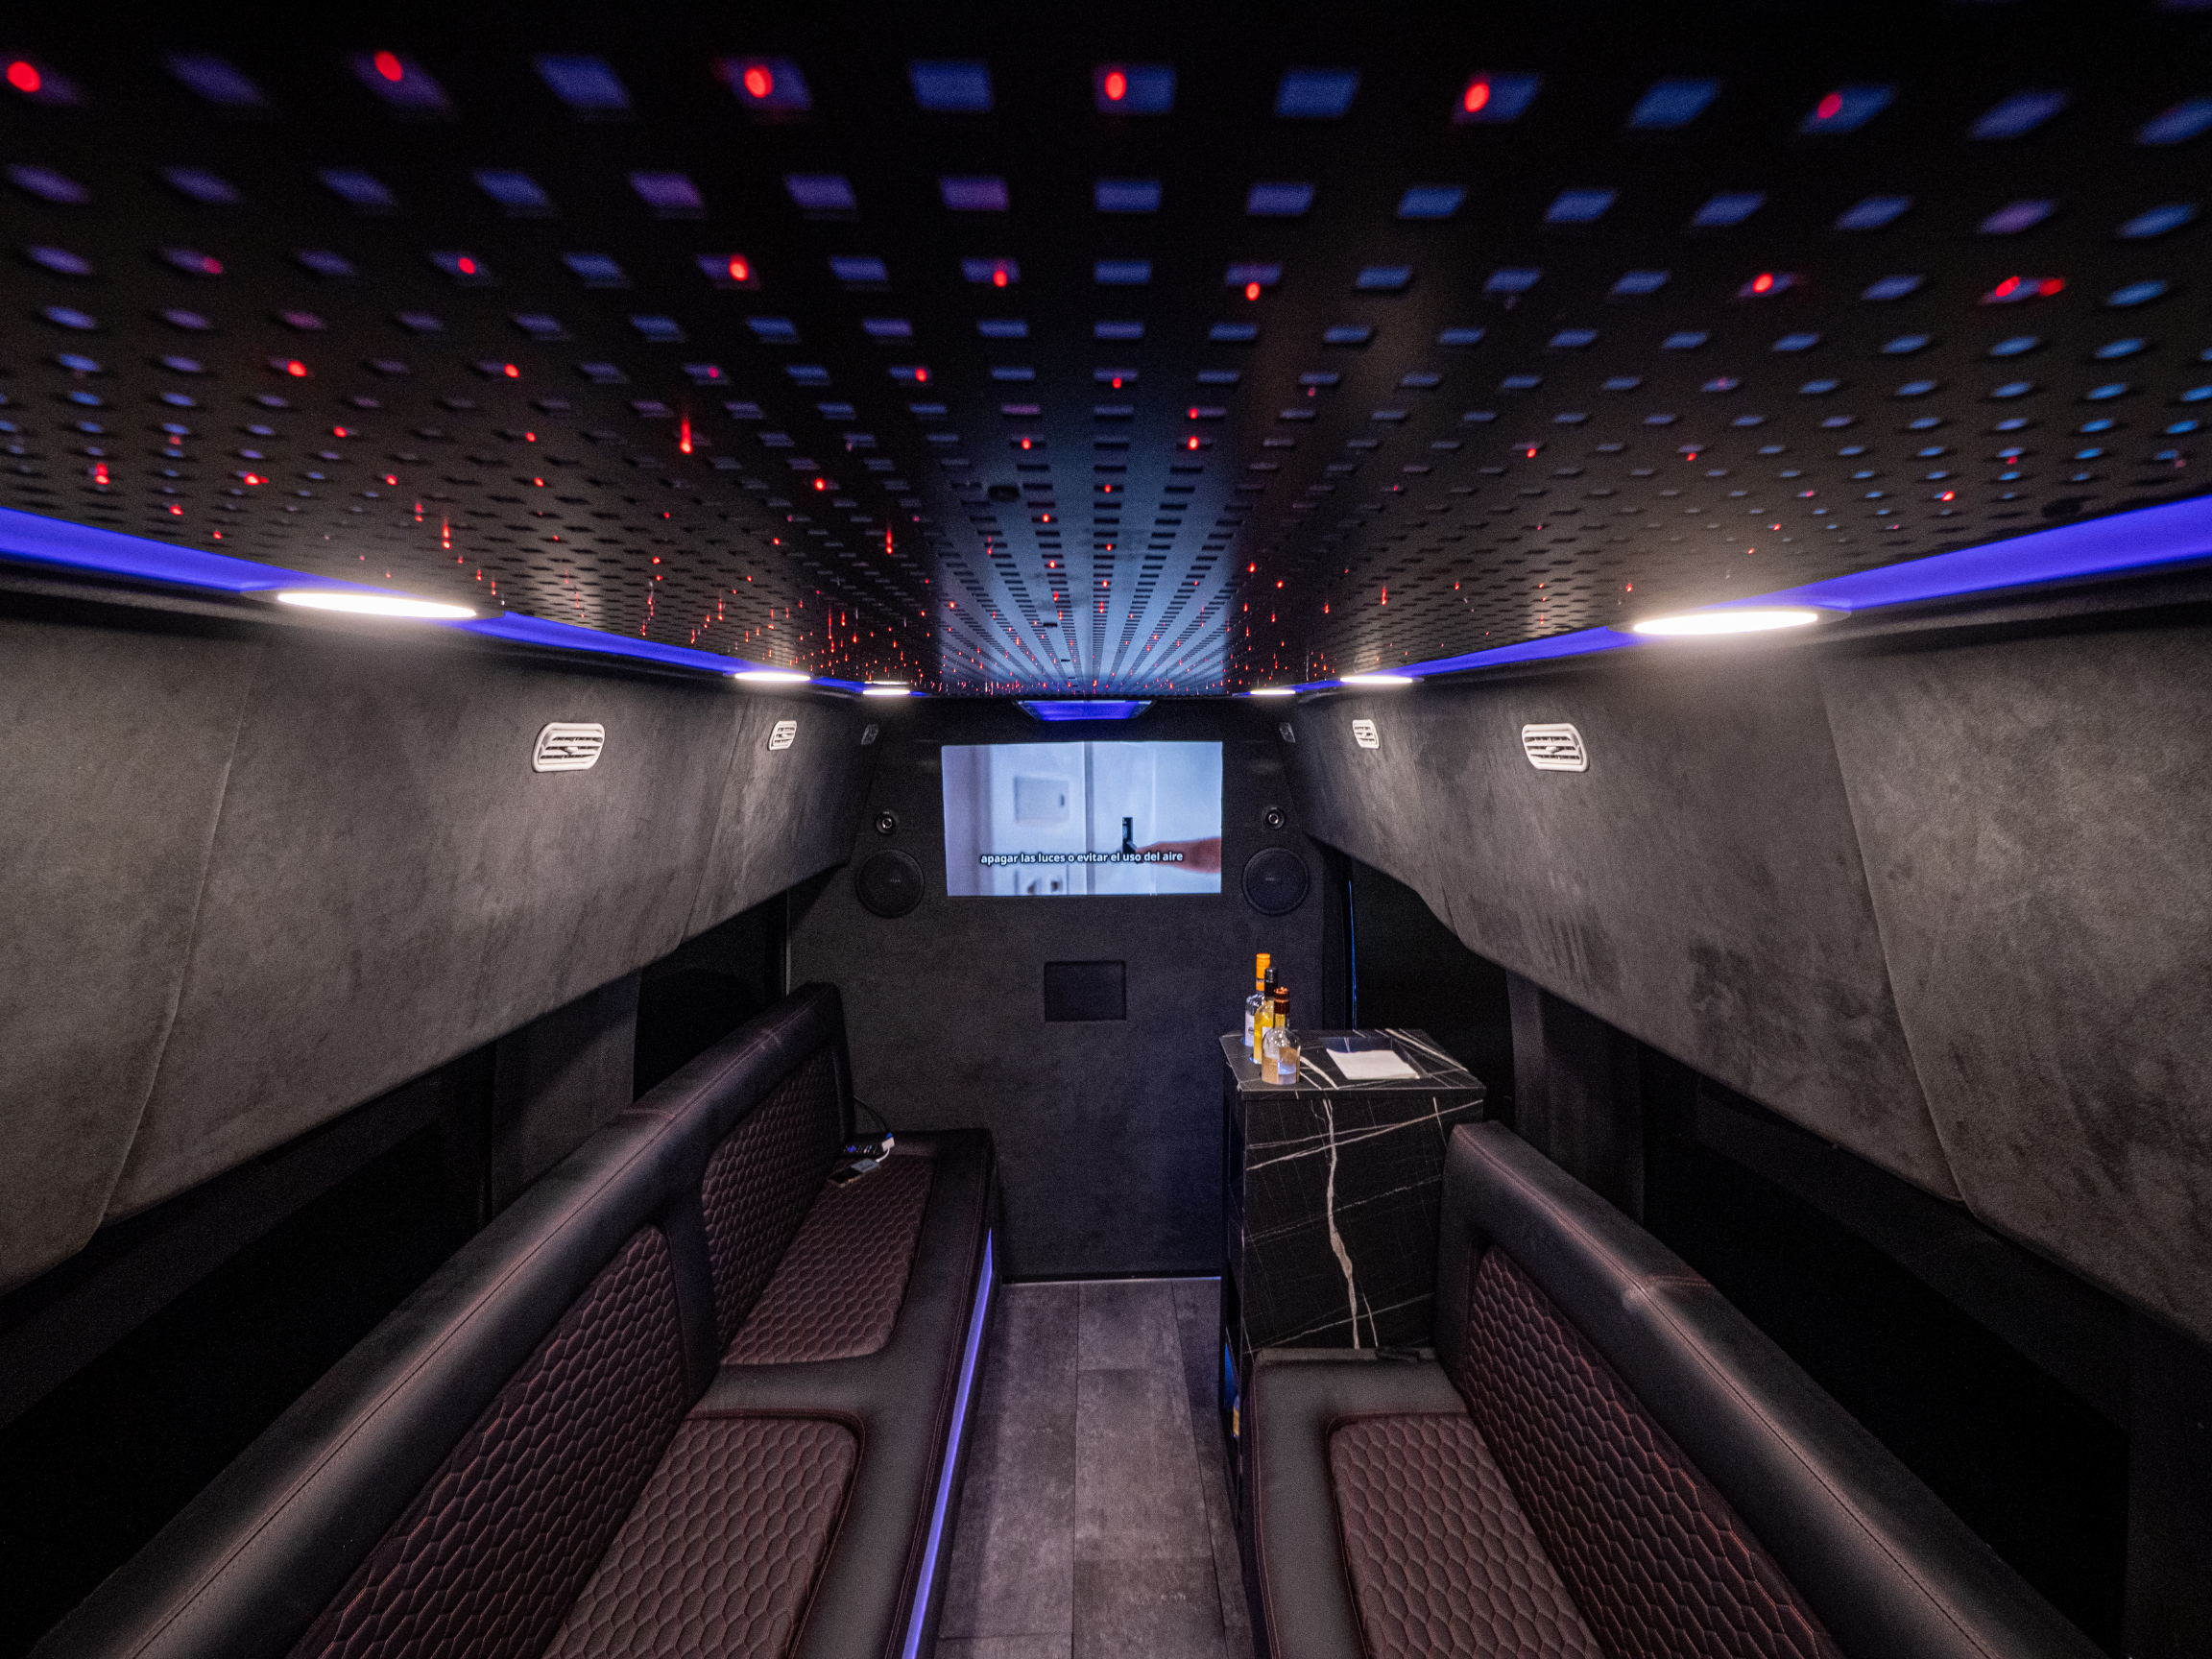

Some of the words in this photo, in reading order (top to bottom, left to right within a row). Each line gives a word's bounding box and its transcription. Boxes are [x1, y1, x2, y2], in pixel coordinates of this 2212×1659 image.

[980, 854, 1018, 866] apagar
[1020, 853, 1036, 863] las
[1038, 853, 1066, 863] luces
[1068, 854, 1075, 863] o
[1076, 852, 1108, 862] evitar
[1110, 852, 1120, 862] el
[1122, 853, 1142, 862] uso
[1143, 851, 1161, 862] del
[1162, 851, 1184, 861] aire
